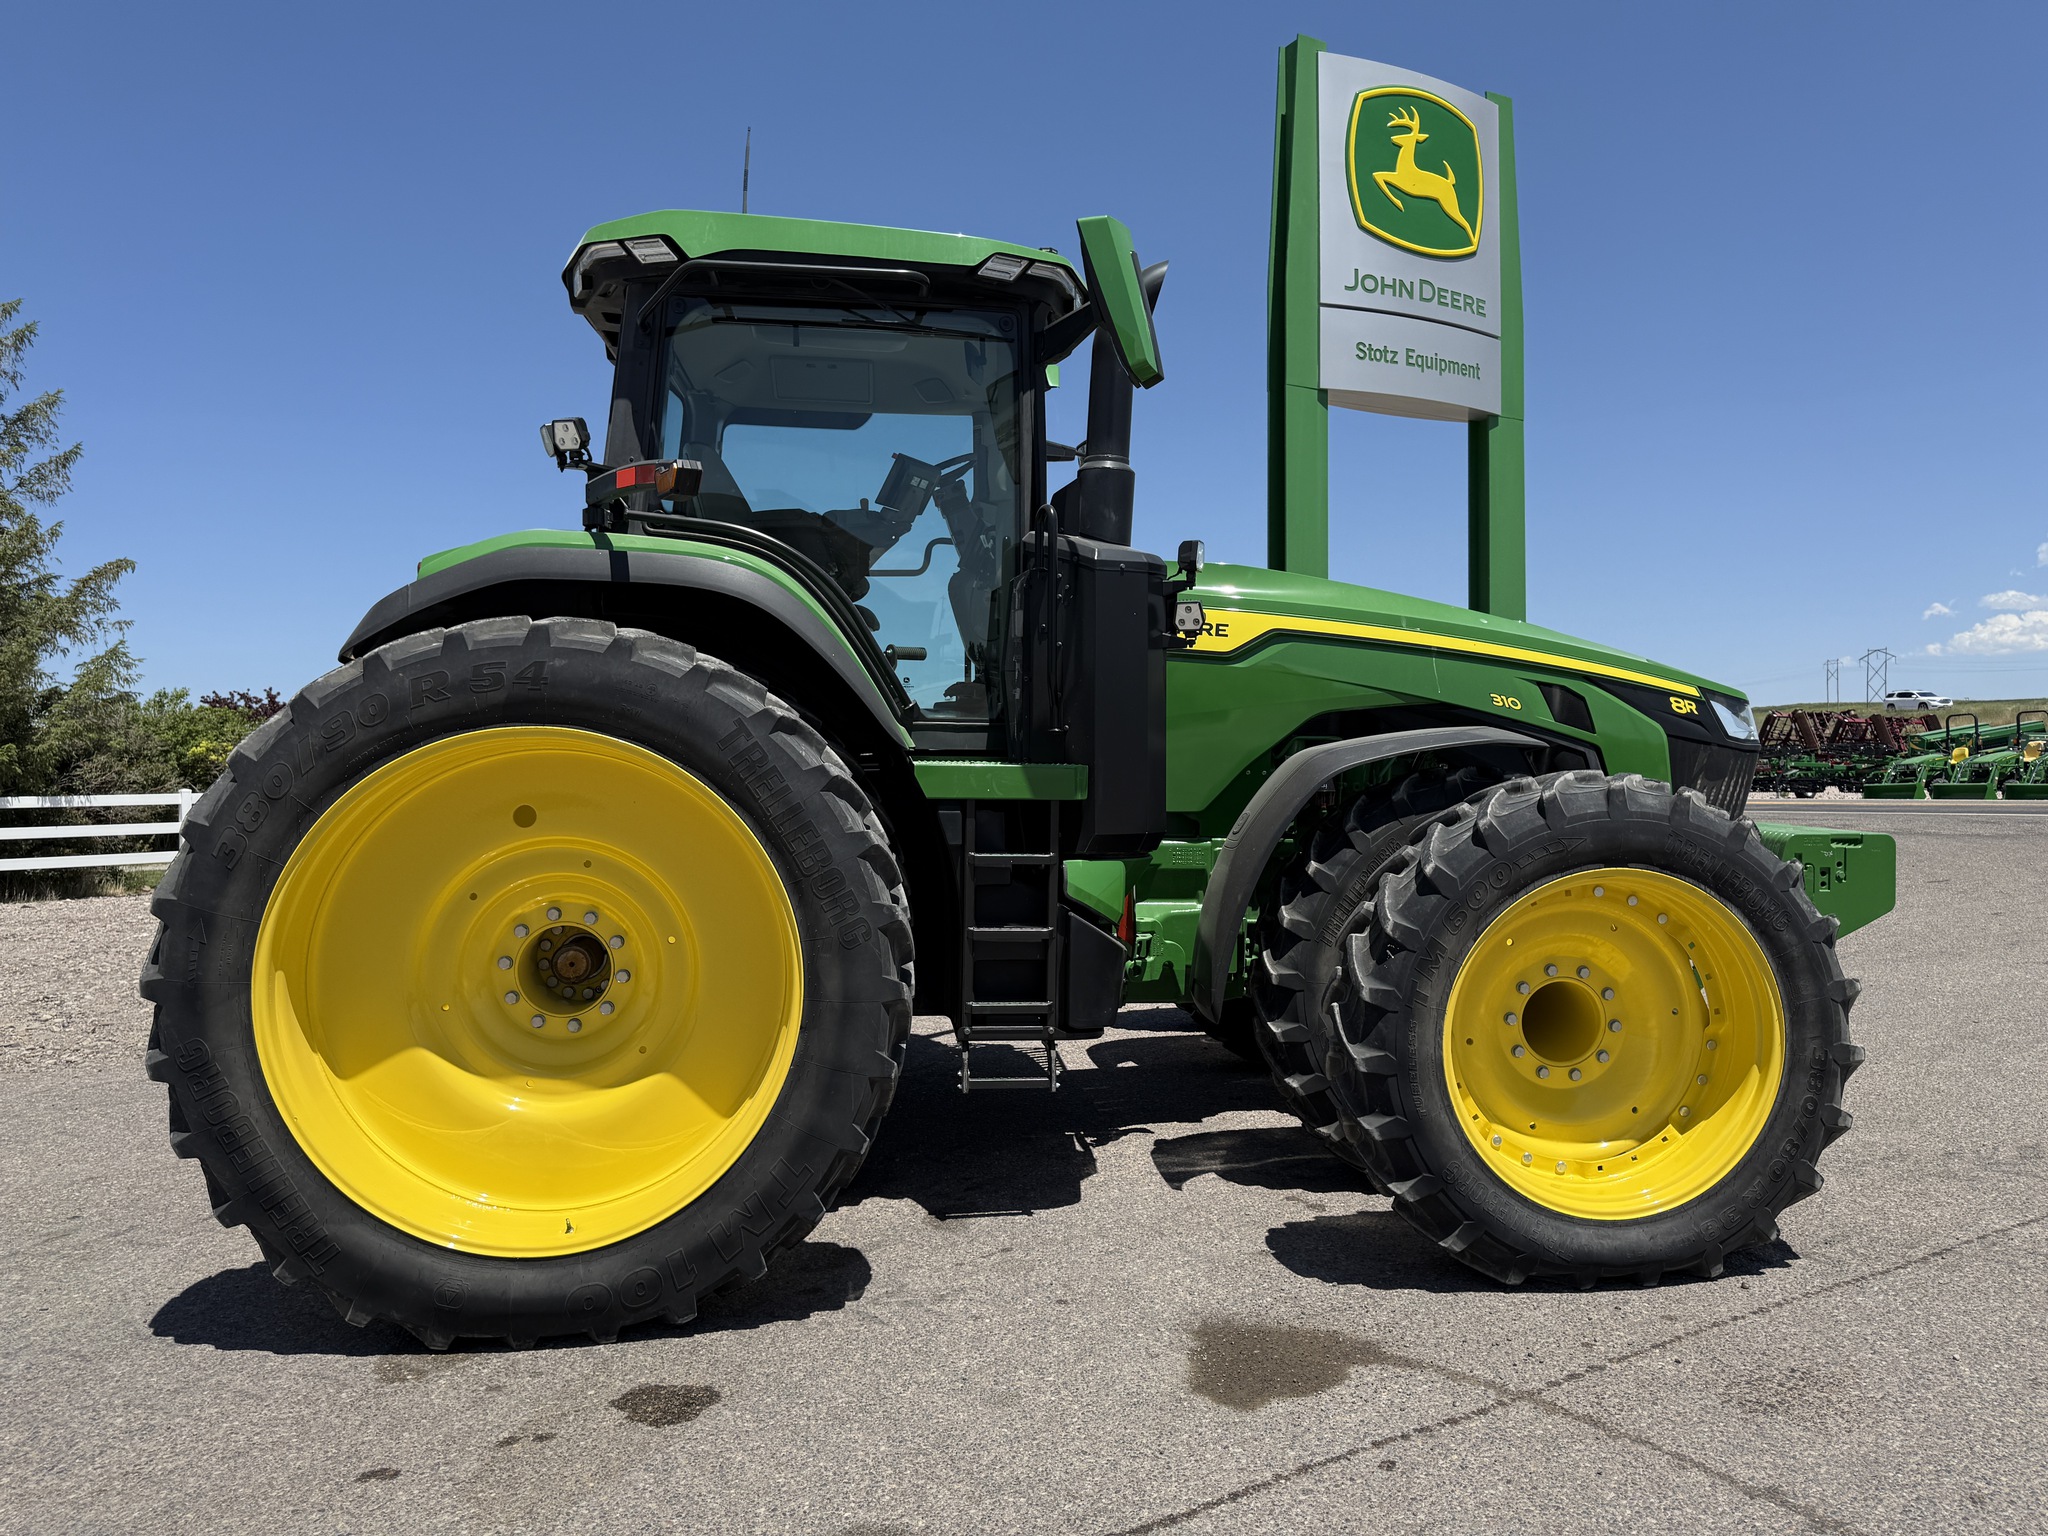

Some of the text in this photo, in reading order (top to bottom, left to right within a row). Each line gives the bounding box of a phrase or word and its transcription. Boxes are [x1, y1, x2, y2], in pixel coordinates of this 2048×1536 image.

[1344, 268, 1487, 318] JOHN DEERE
[1355, 341, 1481, 380] Stotz Equipment
[1489, 693, 1522, 710] 310
[1669, 696, 1699, 715] 8R
[211, 692, 390, 872] 380/90
[468, 660, 549, 694] 54
[715, 716, 874, 951] TRELLEBORG
[1663, 829, 1793, 932] TRELLEBORG
[1441, 859, 1514, 936] 600
[1407, 1018, 1428, 1120] TUBELESS
[1767, 1045, 1829, 1183] 380/80
[174, 1036, 342, 1277] TRELLEBORG
[1441, 1160, 1574, 1264] TRELLEBORG
[1700, 1204, 1742, 1243] 38
